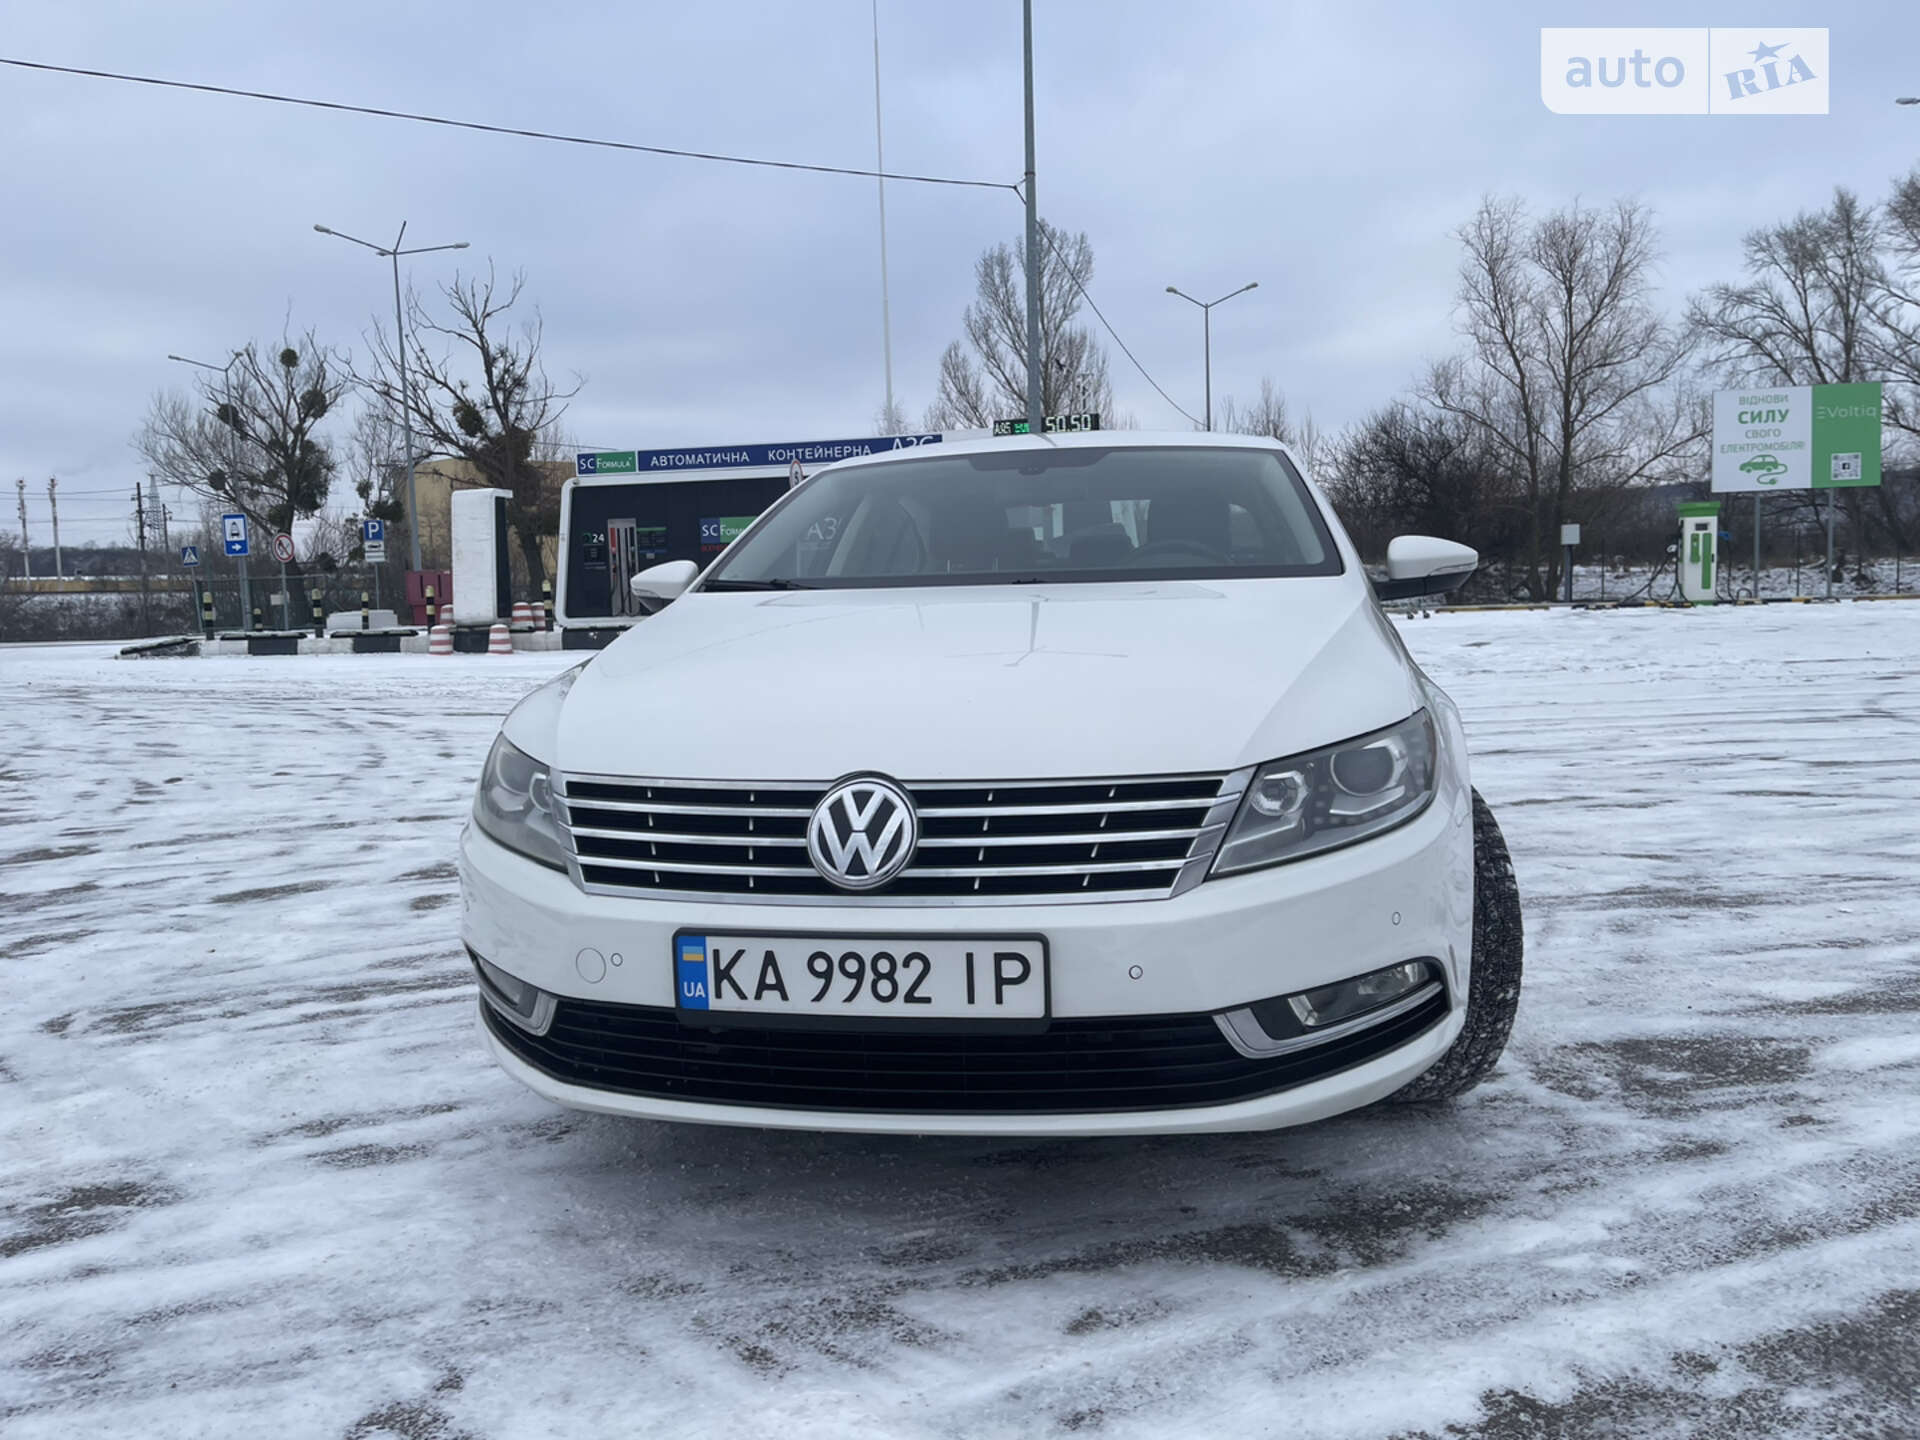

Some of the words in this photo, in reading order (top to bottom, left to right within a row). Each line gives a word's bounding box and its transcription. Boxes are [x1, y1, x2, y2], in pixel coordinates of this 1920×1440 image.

[1045, 414, 1091, 432] 50.50
[1738, 409, 1789, 424] СИЛУ
[1745, 428, 1781, 439] СВОГО
[579, 457, 595, 469] SC
[650, 451, 750, 467] АВТОМАТИЧНА
[768, 445, 872, 461] КОНТЕЙНЕРНА
[368, 522, 379, 538] P
[702, 524, 718, 537] SC
[592, 533, 605, 543] 24
[713, 949, 790, 1001] KA
[807, 951, 932, 1004] 9982
[965, 952, 1031, 1005] IP
[684, 982, 706, 998] UA
